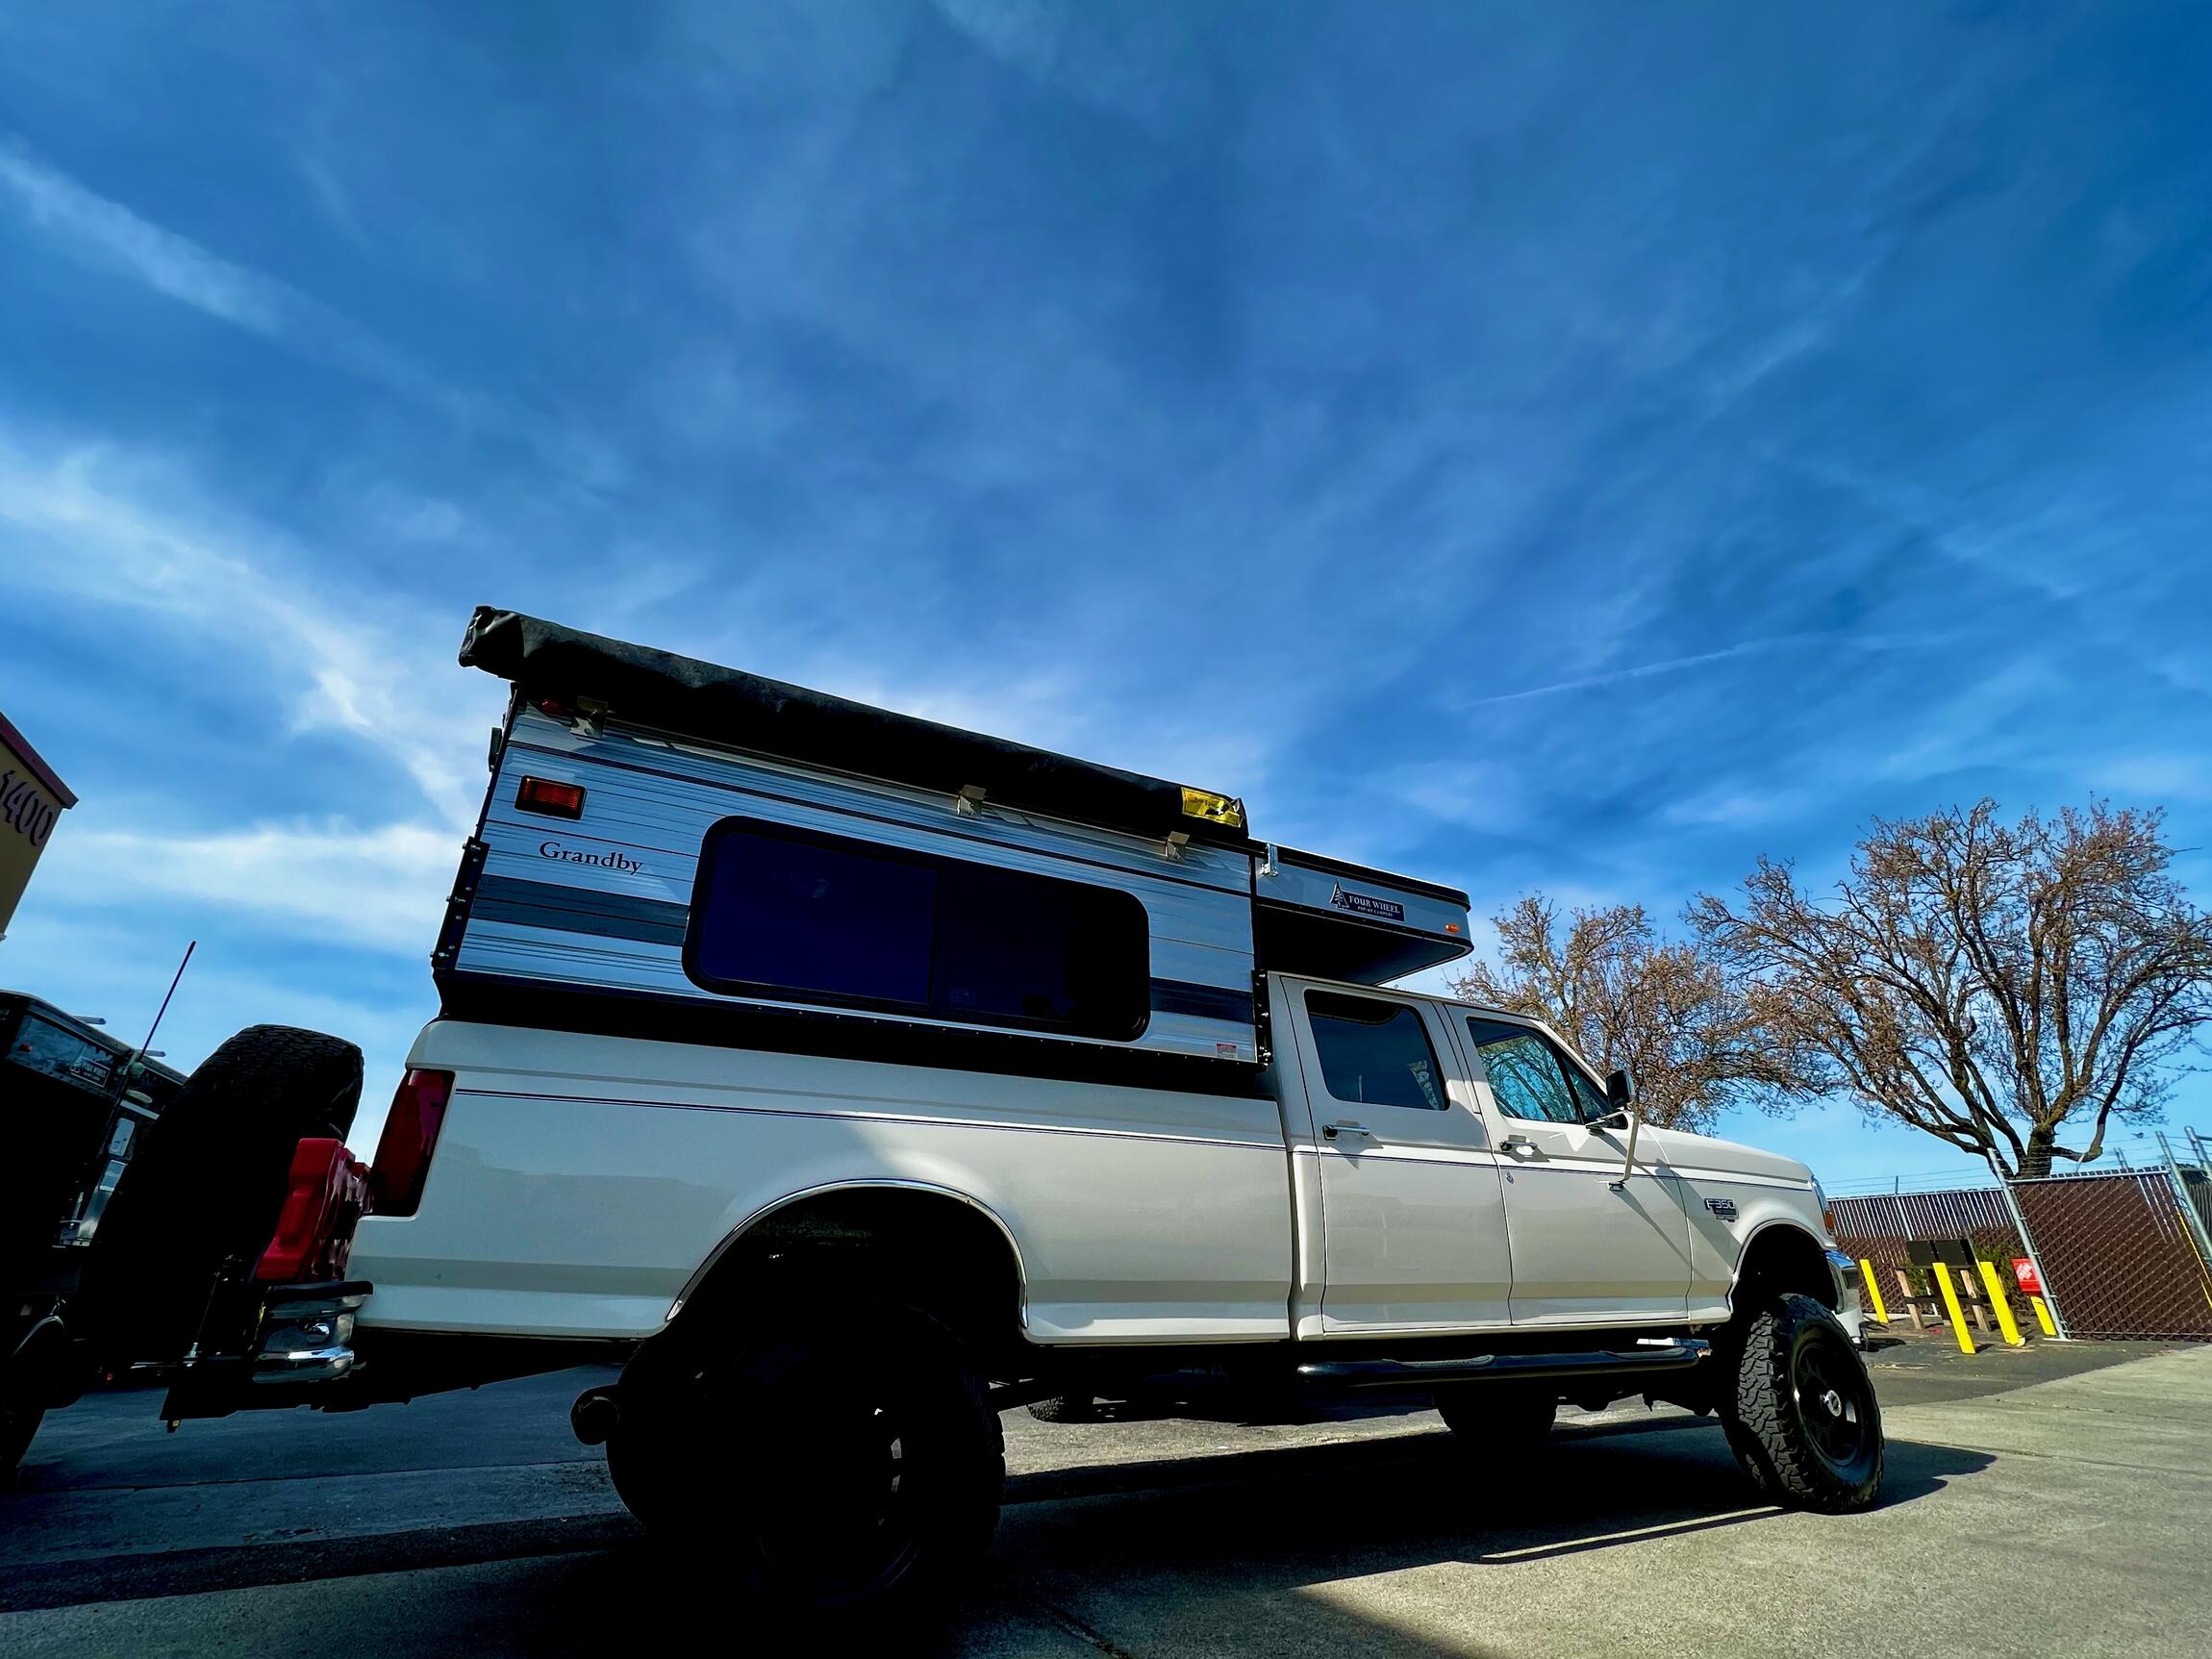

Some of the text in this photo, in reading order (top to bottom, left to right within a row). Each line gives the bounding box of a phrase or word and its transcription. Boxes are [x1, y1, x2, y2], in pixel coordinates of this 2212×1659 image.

[540, 842, 643, 874] Grandby
[1349, 895, 1400, 914] FOUR WHEEL
